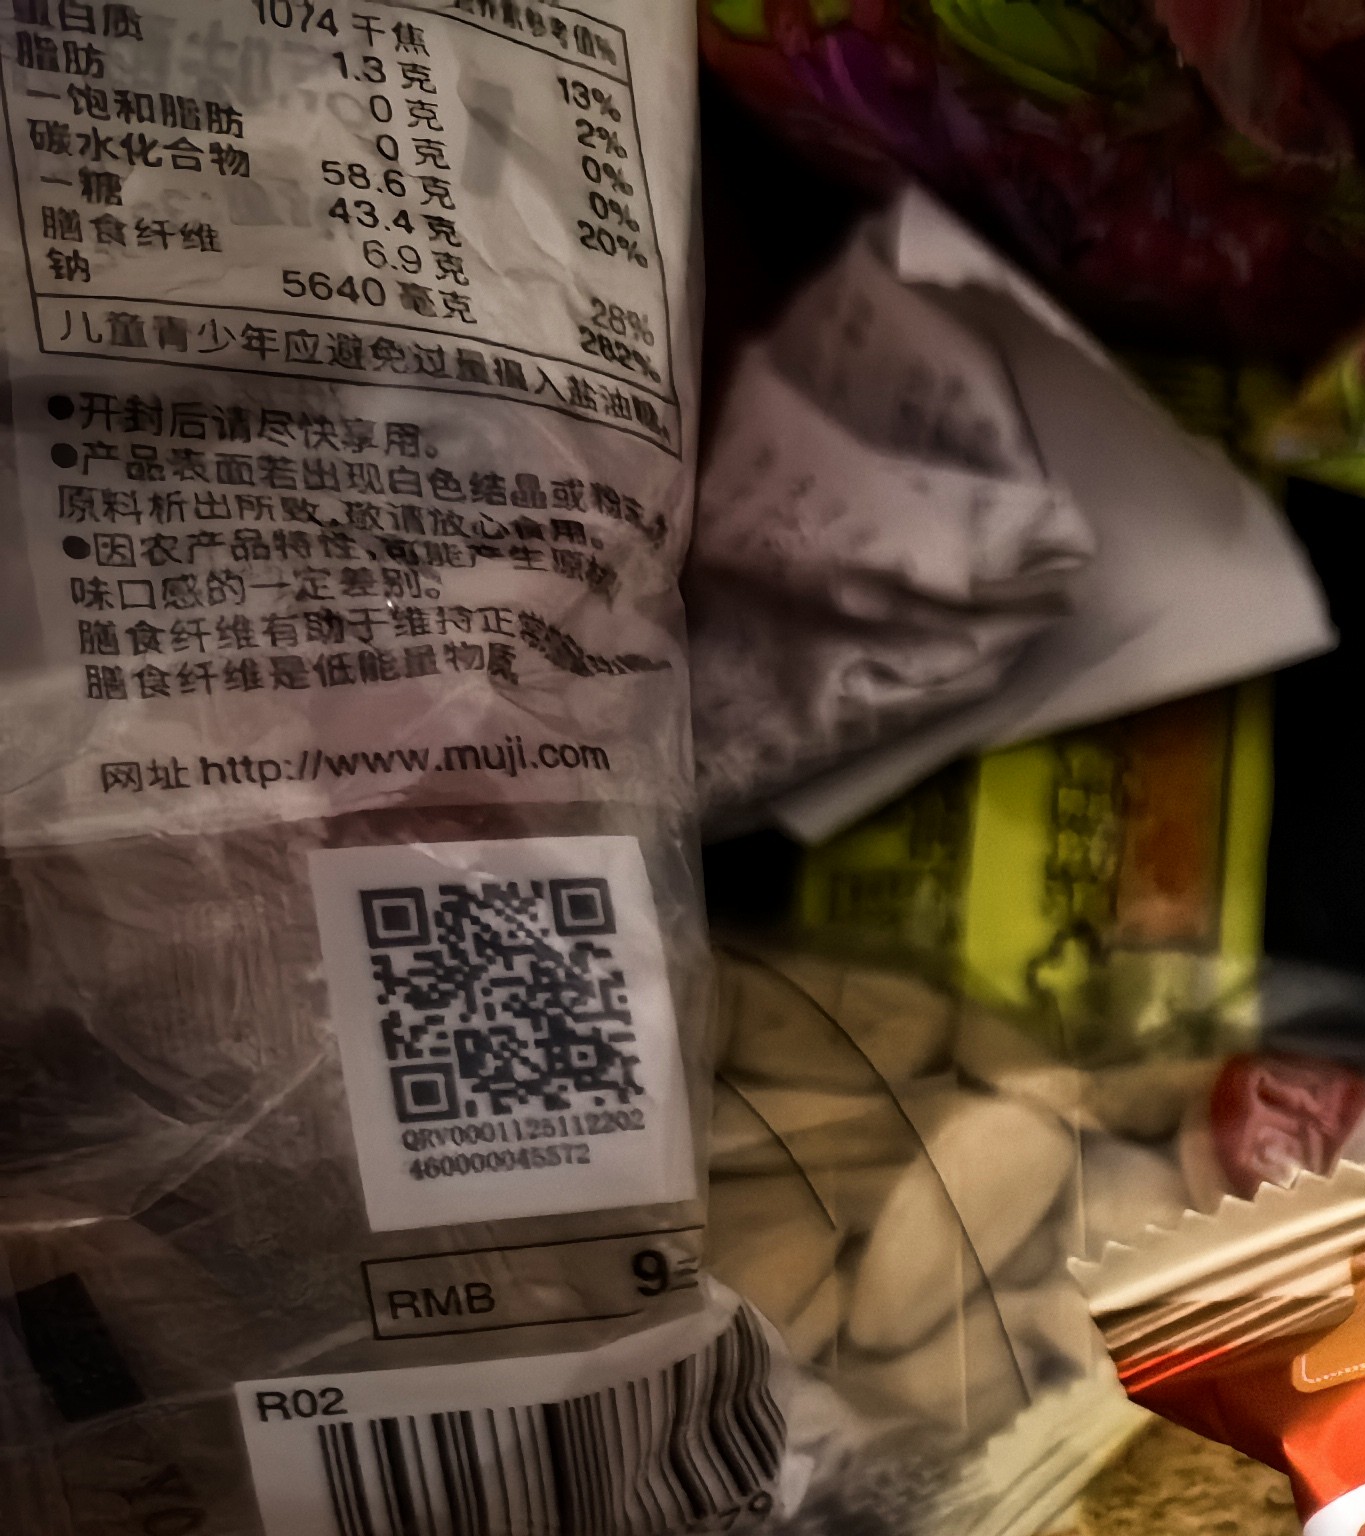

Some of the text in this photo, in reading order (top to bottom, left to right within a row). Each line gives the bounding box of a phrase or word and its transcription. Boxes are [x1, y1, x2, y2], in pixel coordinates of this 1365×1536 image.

[332, 52, 438, 94] 1.3 克
[370, 97, 446, 130] 0 克
[558, 77, 621, 121] 13%
[28, 119, 250, 177] 碳水化合物
[376, 135, 452, 170] 0 克
[577, 118, 627, 158] 2%
[322, 161, 457, 211] 58.6 克
[582, 157, 633, 196] 0%
[328, 197, 463, 248] 43.4 克
[590, 194, 639, 233] 0%
[363, 240, 469, 286] 6.9 克
[578, 221, 647, 269] 20%
[283, 271, 387, 306] 5640
[101, 740, 611, 794] 网址 http://www.muji.com
[388, 1283, 496, 1319] RMB
[255, 1387, 349, 1423] R02
